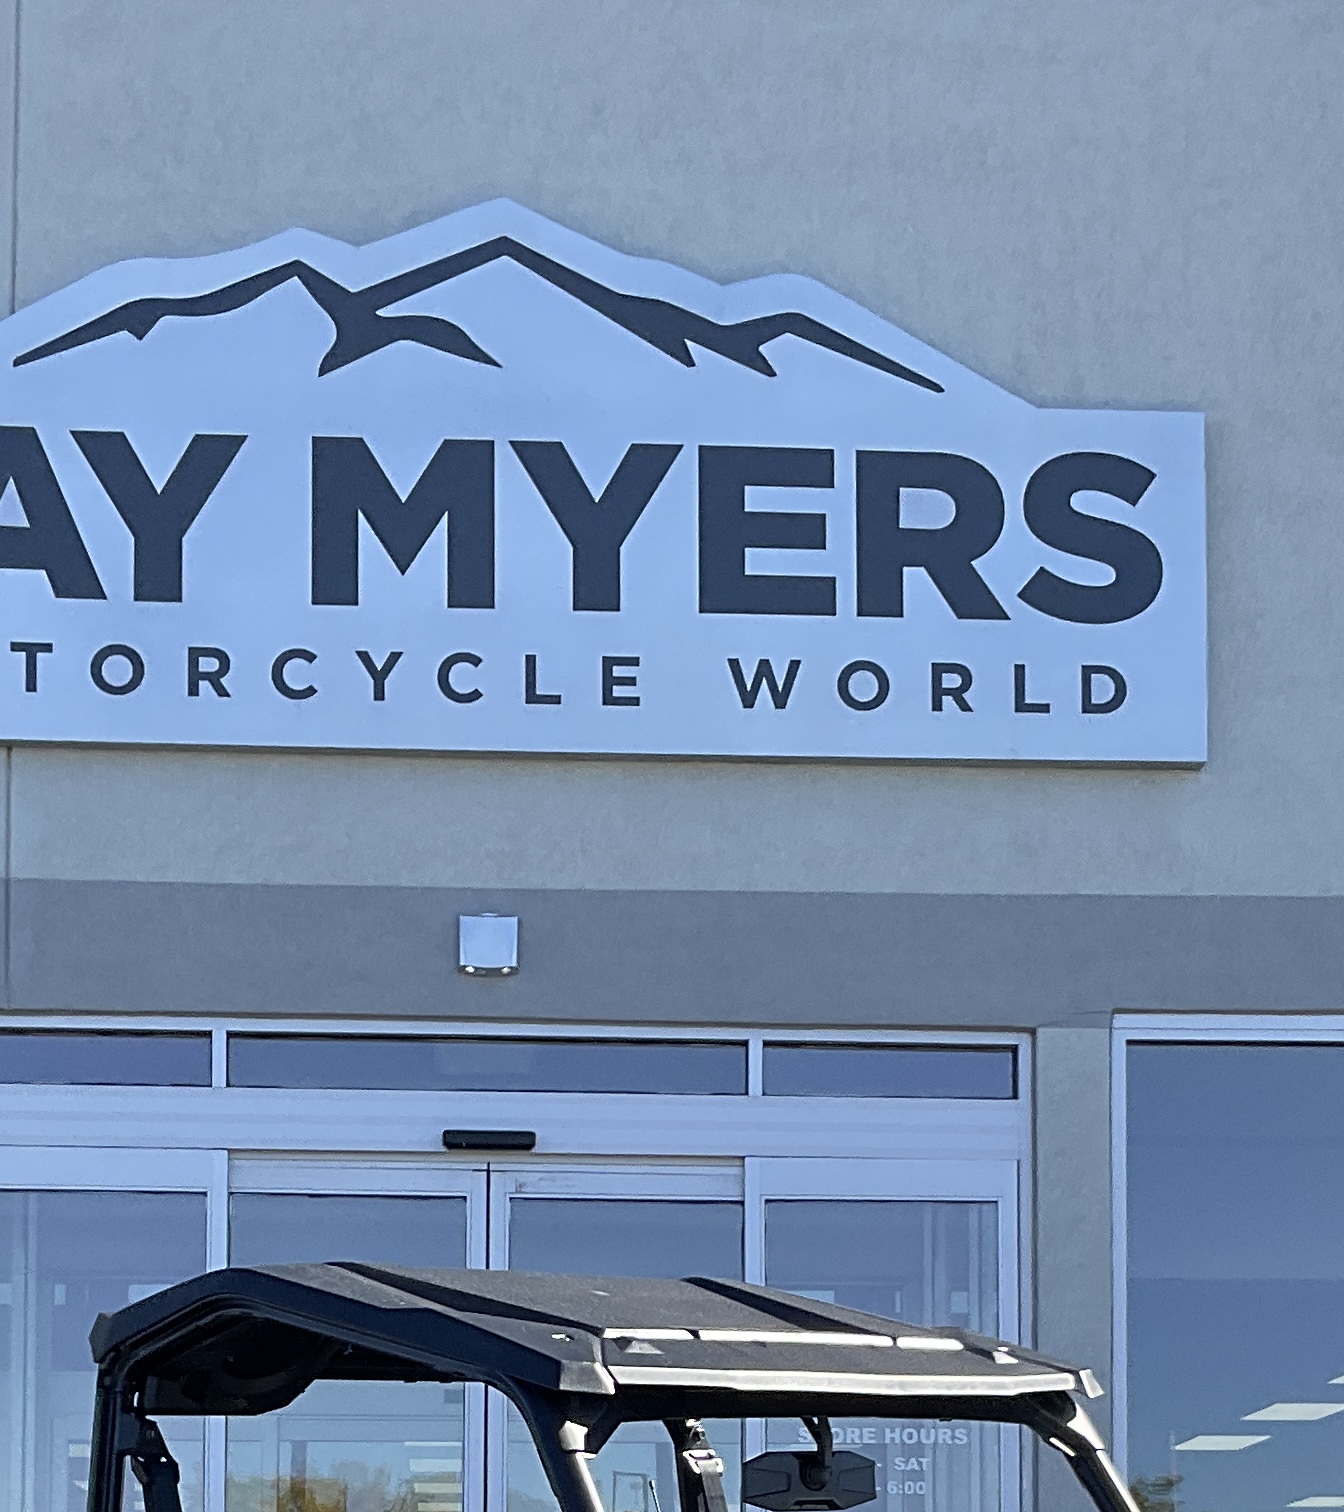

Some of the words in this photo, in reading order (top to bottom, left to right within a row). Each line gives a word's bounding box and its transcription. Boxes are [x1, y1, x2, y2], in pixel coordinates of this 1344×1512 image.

[311, 435, 1164, 625] MYERS
[727, 657, 1128, 715] WORLD
[798, 1427, 877, 1444] SORE
[884, 1427, 969, 1445] HOURS
[893, 1457, 929, 1471] SAT
[886, 1480, 927, 1495] 6:00
